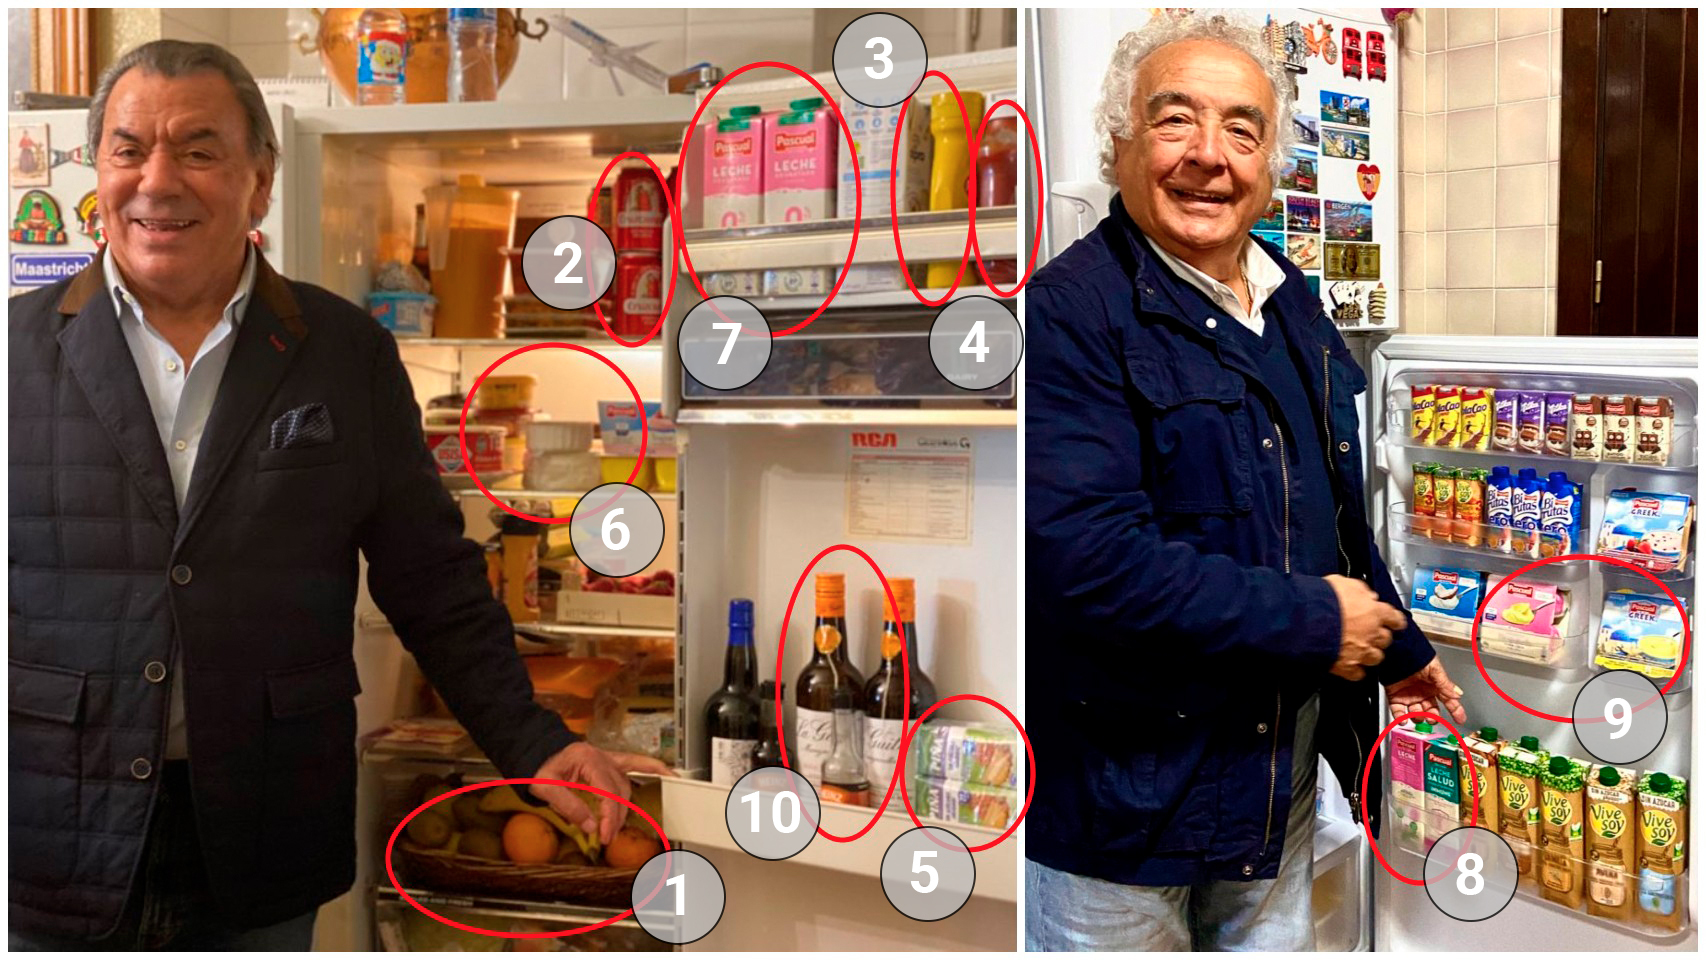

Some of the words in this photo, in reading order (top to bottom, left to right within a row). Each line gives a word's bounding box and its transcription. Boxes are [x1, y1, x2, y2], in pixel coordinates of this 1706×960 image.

[712, 164, 751, 178] LECHE
[774, 158, 816, 172] LECHE
[852, 432, 897, 449] RCA
[1513, 493, 1523, 505] Bi
[1545, 497, 1555, 510] Bi
[1427, 772, 1455, 788] SALUD
[1461, 765, 1483, 781] Vie
[1501, 777, 1526, 792] Vive
[1508, 791, 1529, 806] soy
[1542, 791, 1568, 807] Vive
[1550, 806, 1571, 821] soy
[1590, 804, 1622, 820] Vive
[1641, 811, 1673, 828] Vive
[1601, 819, 1625, 833] soy
[1651, 827, 1676, 841] soy
